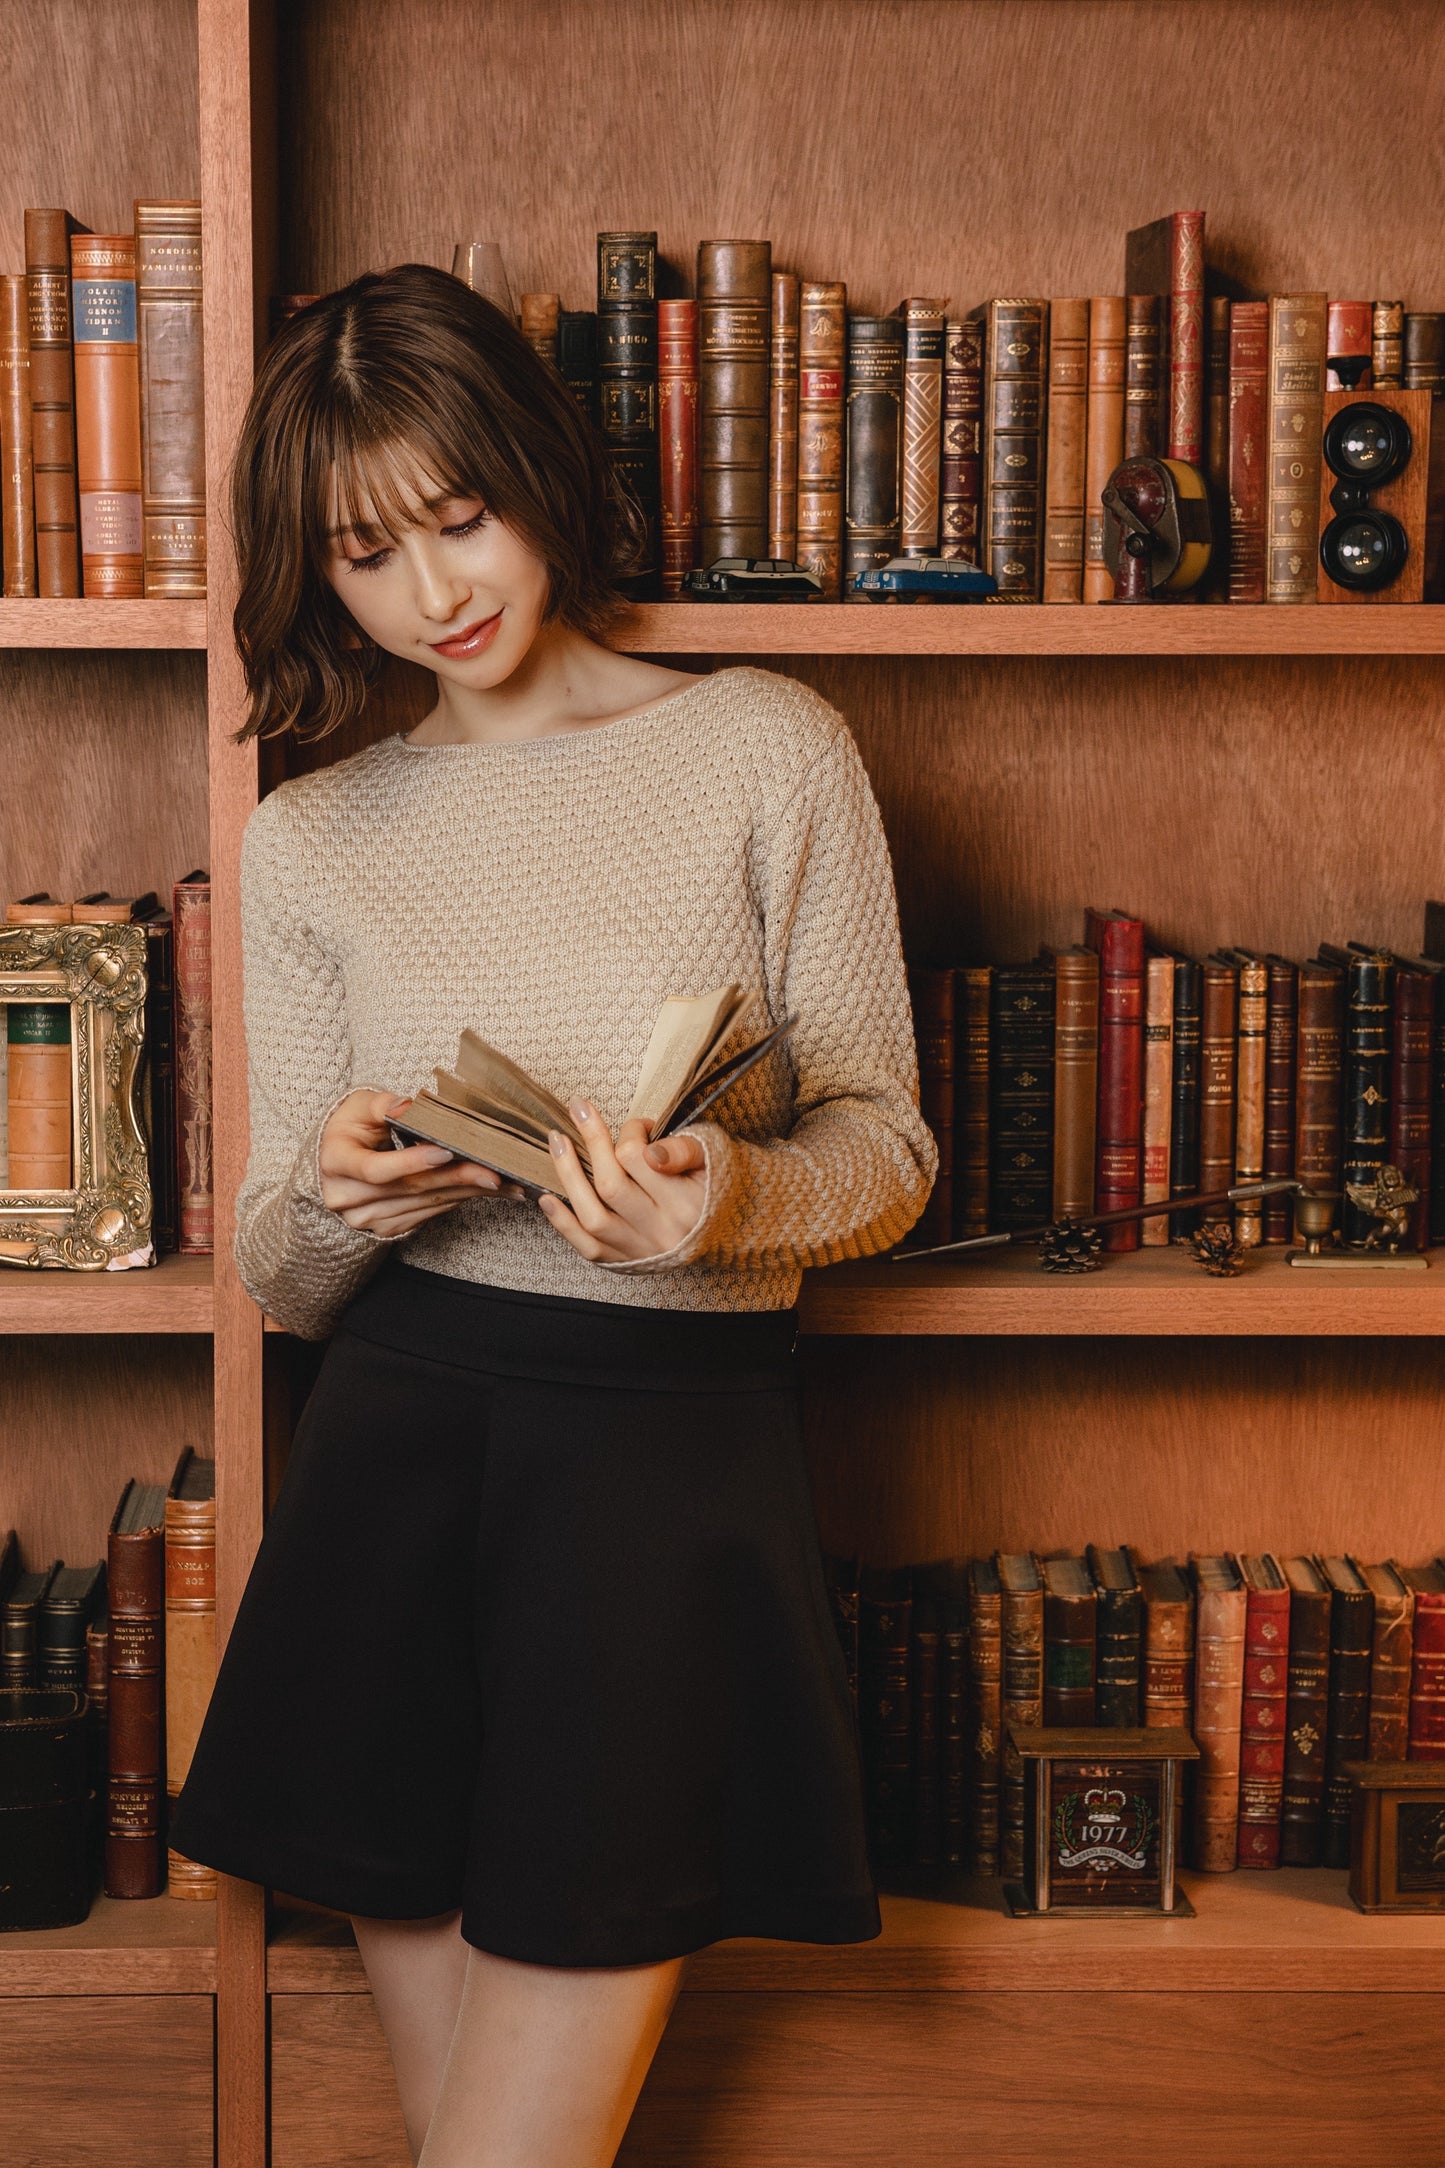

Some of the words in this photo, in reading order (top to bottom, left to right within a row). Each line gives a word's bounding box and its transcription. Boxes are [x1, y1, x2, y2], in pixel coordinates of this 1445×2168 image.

[619, 335, 648, 344] HUGO
[12, 473, 22, 484] 12
[109, 1793, 141, 1802] FRANCE
[1081, 1825, 1128, 1843] 1977
